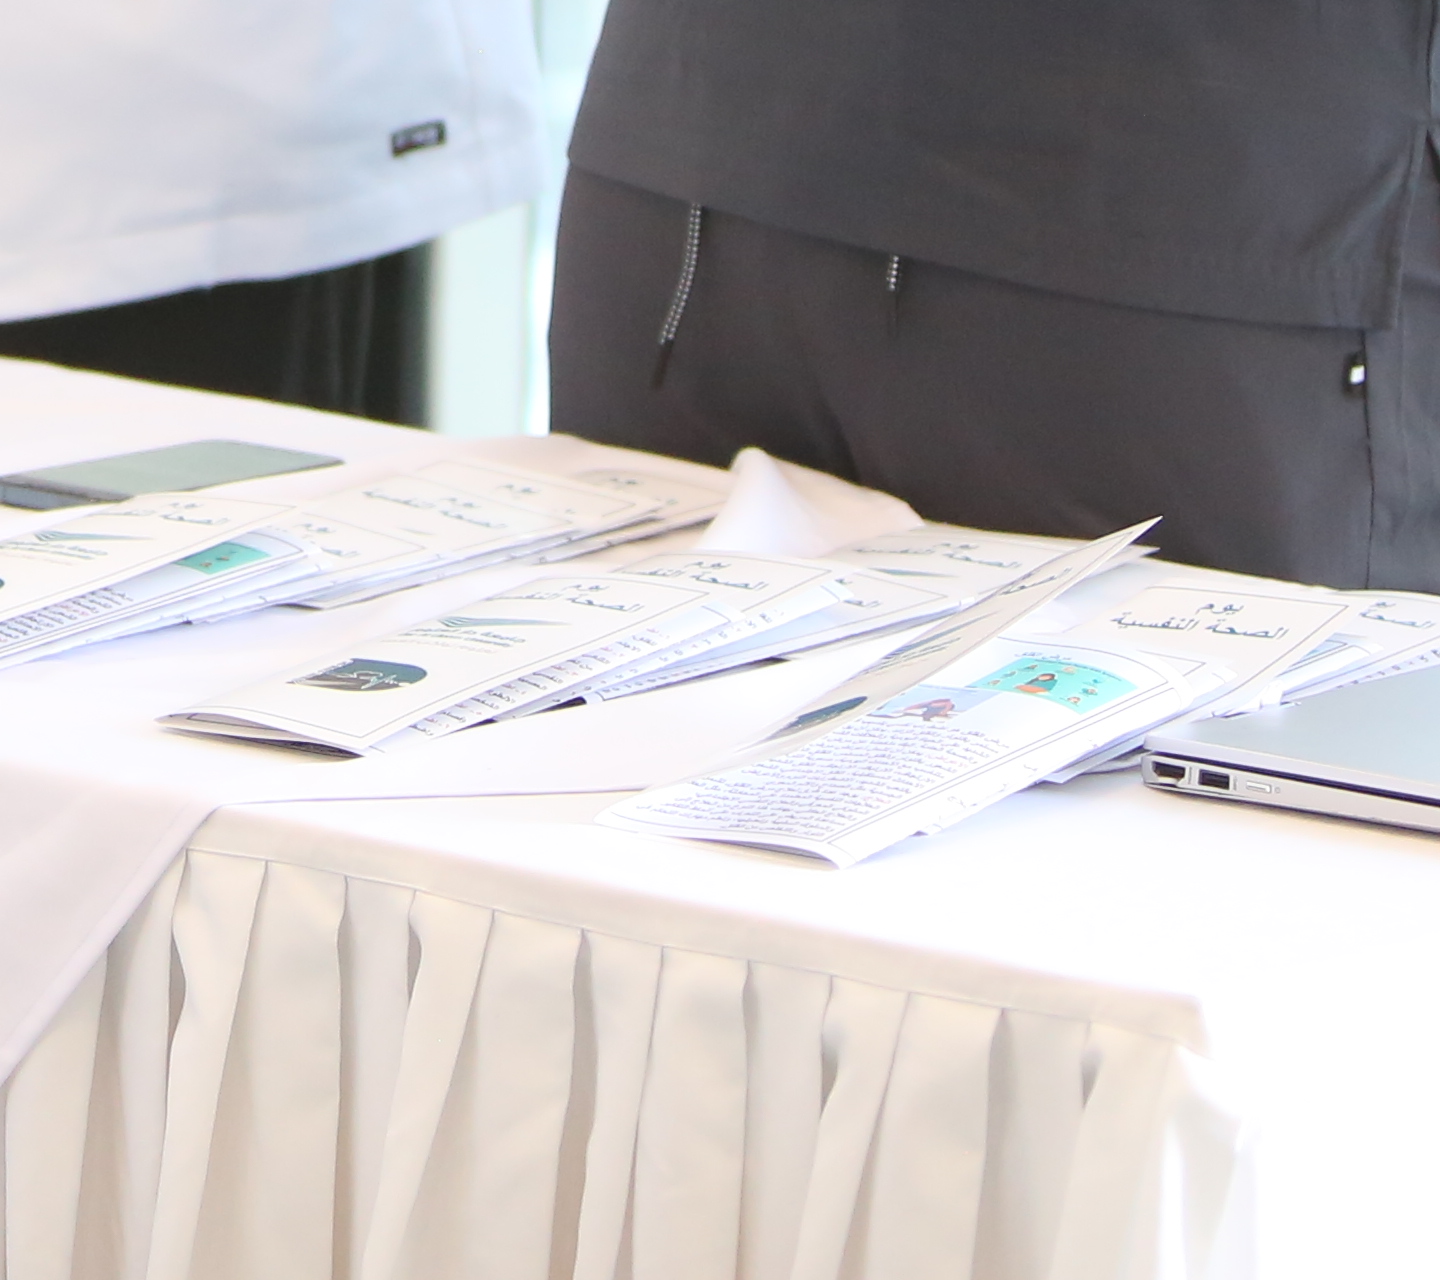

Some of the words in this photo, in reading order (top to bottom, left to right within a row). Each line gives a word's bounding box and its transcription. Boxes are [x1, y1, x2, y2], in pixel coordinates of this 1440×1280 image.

[1195, 603, 1245, 615] يوم
[1110, 611, 1200, 632] النفسية
[1205, 618, 1290, 640] الصحة
